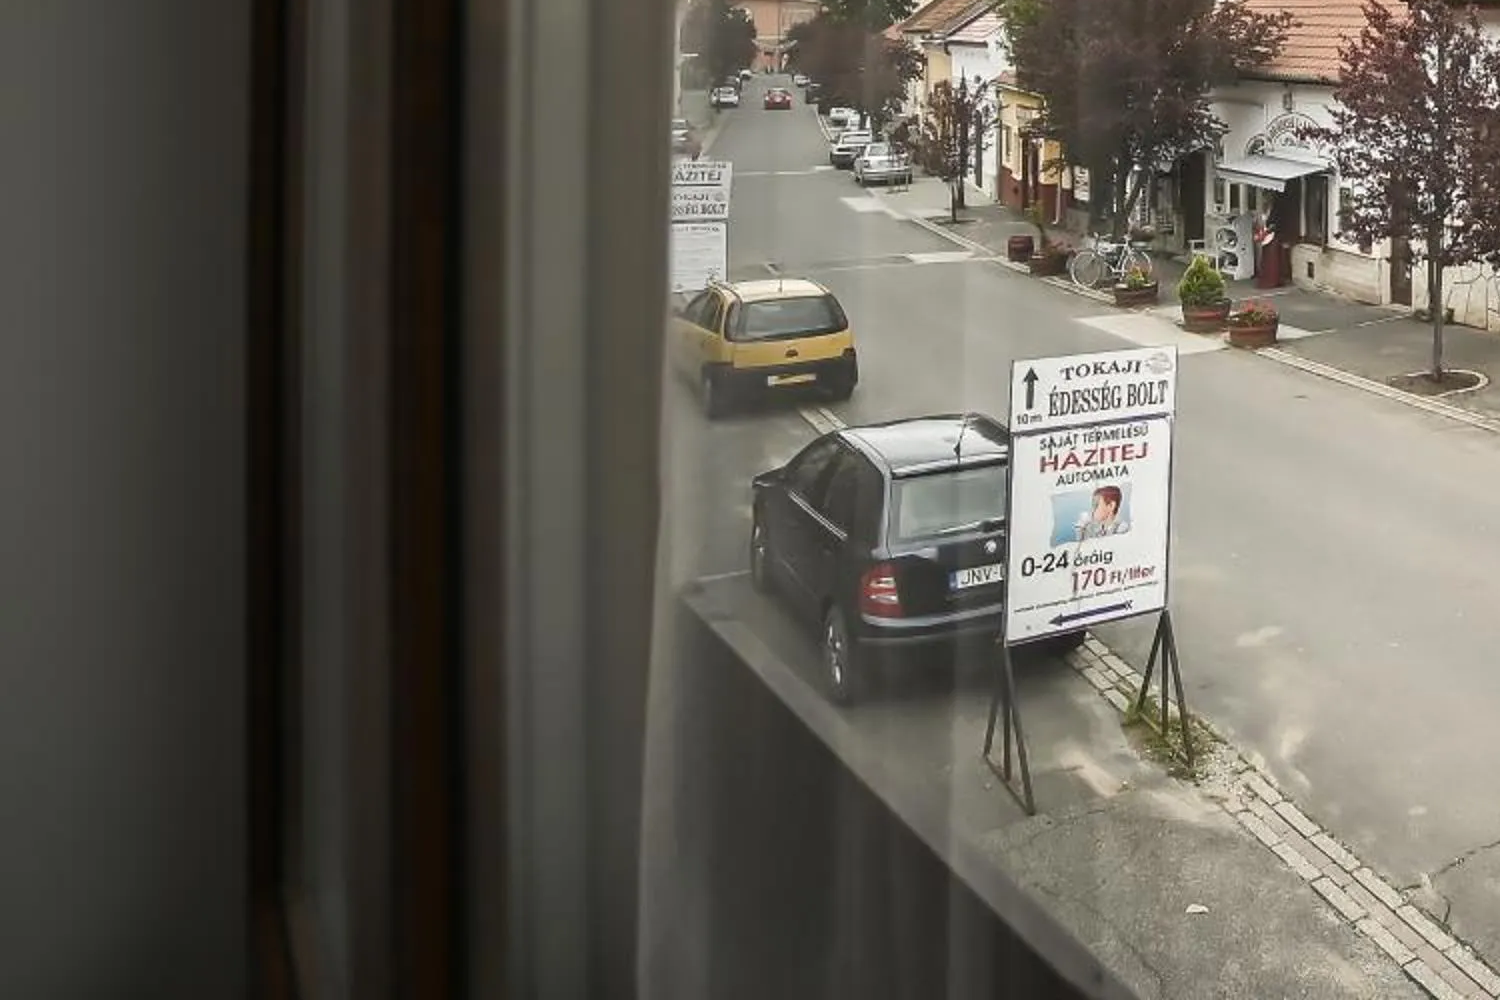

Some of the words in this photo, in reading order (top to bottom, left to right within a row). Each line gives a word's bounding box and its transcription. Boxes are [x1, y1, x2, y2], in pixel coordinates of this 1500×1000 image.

[1060, 360, 1142, 380] TOKAJI
[1048, 380, 1122, 417] ÉDESSÉG
[1126, 380, 1168, 408] BOLT
[1039, 432, 1079, 450] SAJÁT
[1039, 442, 1148, 473] HÁZITEJ
[1056, 465, 1129, 486] AUTOMATA
[1021, 550, 1069, 576] 0-24
[1071, 567, 1106, 593] 170
